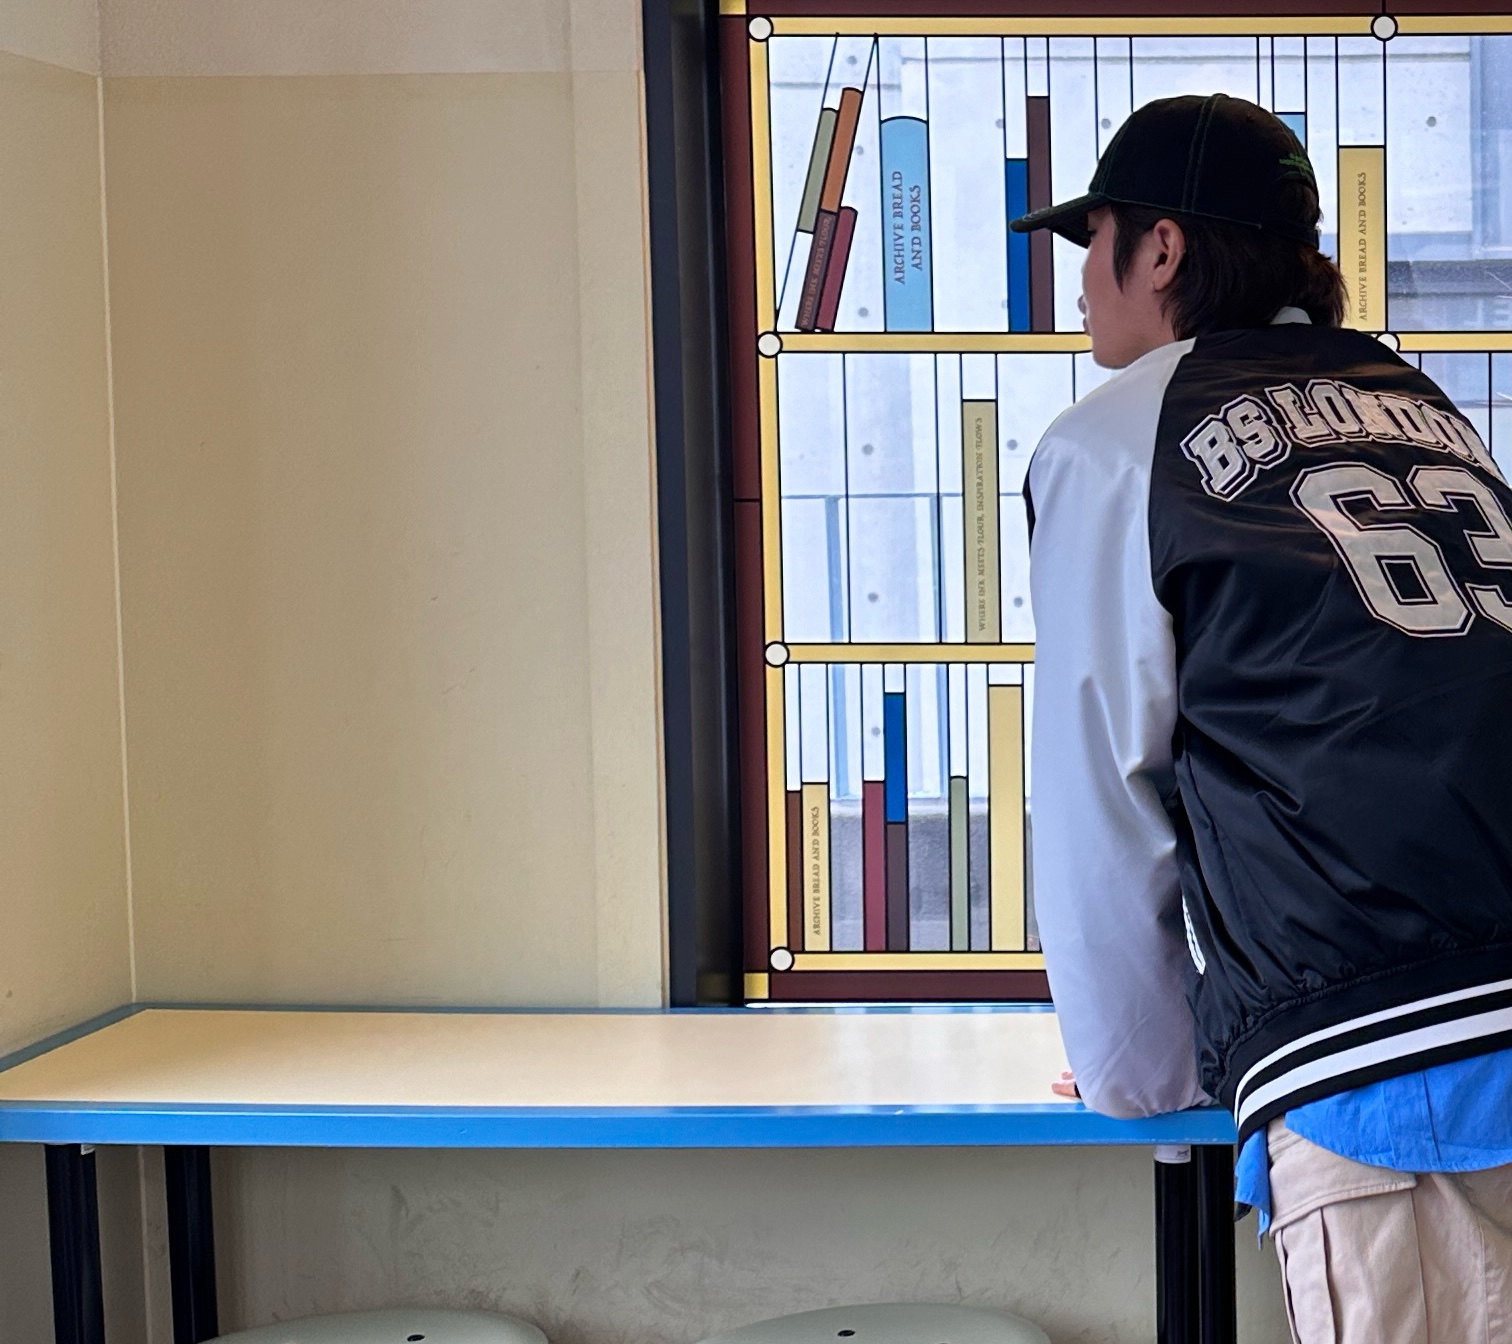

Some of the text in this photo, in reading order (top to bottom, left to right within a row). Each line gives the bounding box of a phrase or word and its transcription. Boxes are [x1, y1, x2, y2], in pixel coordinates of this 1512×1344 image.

[892, 171, 905, 285] ARCHIVE BREAD
[909, 184, 923, 272] AND BOOKS
[1357, 172, 1368, 321] ARCHIVE BREAD AND BOOKS
[1180, 394, 1293, 502] BS
[811, 806, 821, 936] ARCHIVE BREAD AND BOOKS
